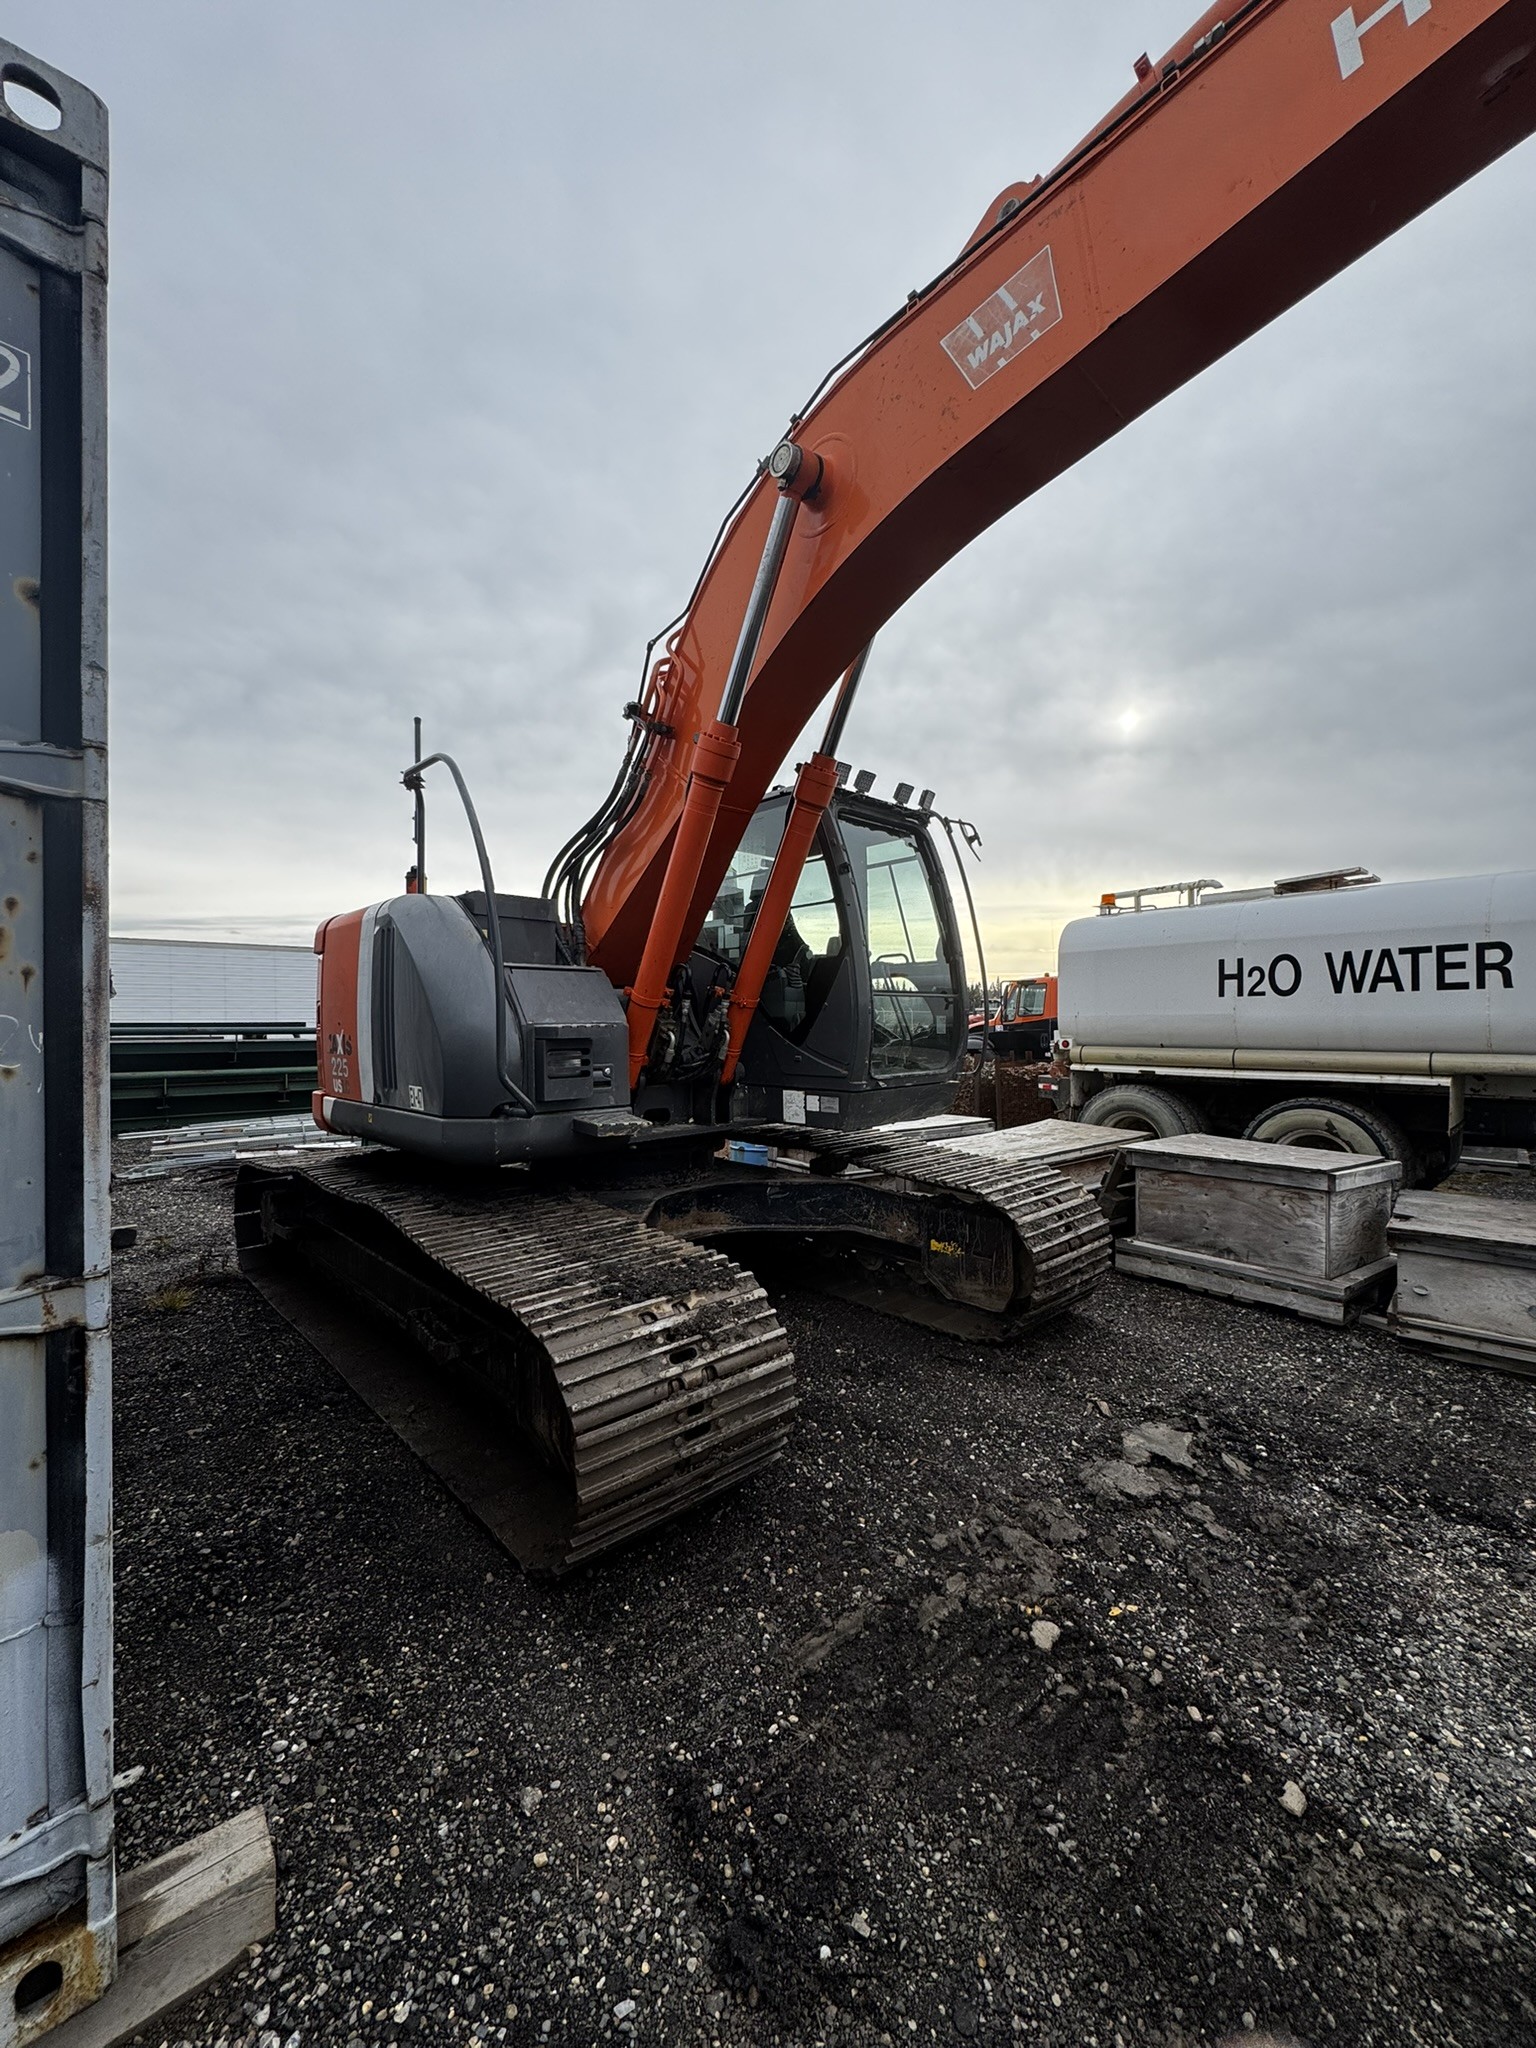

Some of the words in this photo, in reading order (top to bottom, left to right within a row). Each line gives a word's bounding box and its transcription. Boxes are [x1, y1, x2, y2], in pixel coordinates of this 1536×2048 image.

[967, 291, 1046, 369] WAJAX
[1218, 953, 1302, 998] H2O
[1324, 941, 1514, 994] WATER
[331, 1057, 349, 1078] 225
